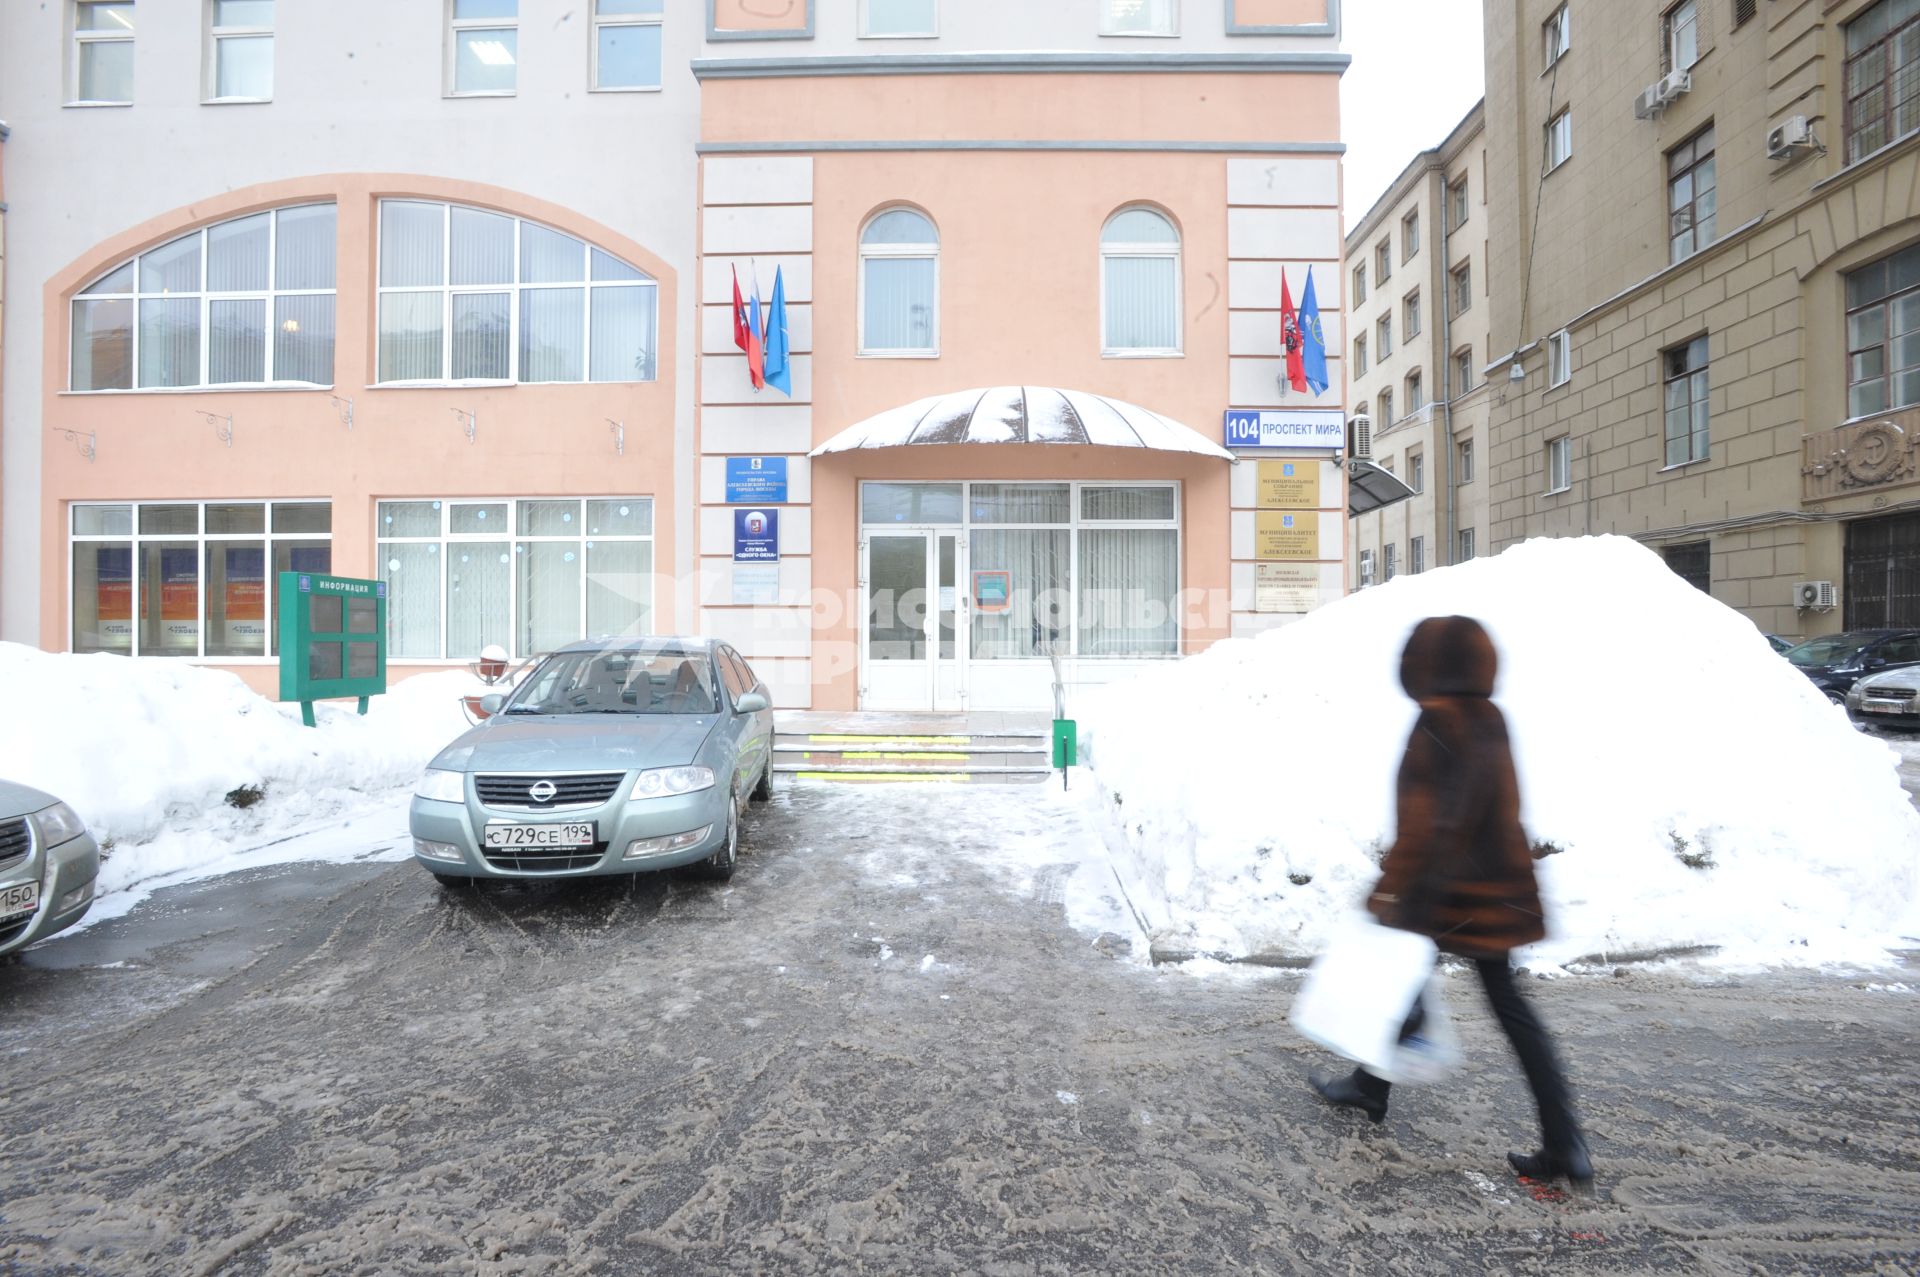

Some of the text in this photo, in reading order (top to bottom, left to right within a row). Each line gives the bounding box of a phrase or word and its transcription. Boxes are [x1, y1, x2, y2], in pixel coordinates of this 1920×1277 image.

[1230, 418, 1341, 439] 104 ПРОСПЕКТ МИРА
[320, 581, 369, 593] ИНФОРМАЦИЯ
[563, 825, 588, 838] 199
[1, 887, 32, 907] 150
